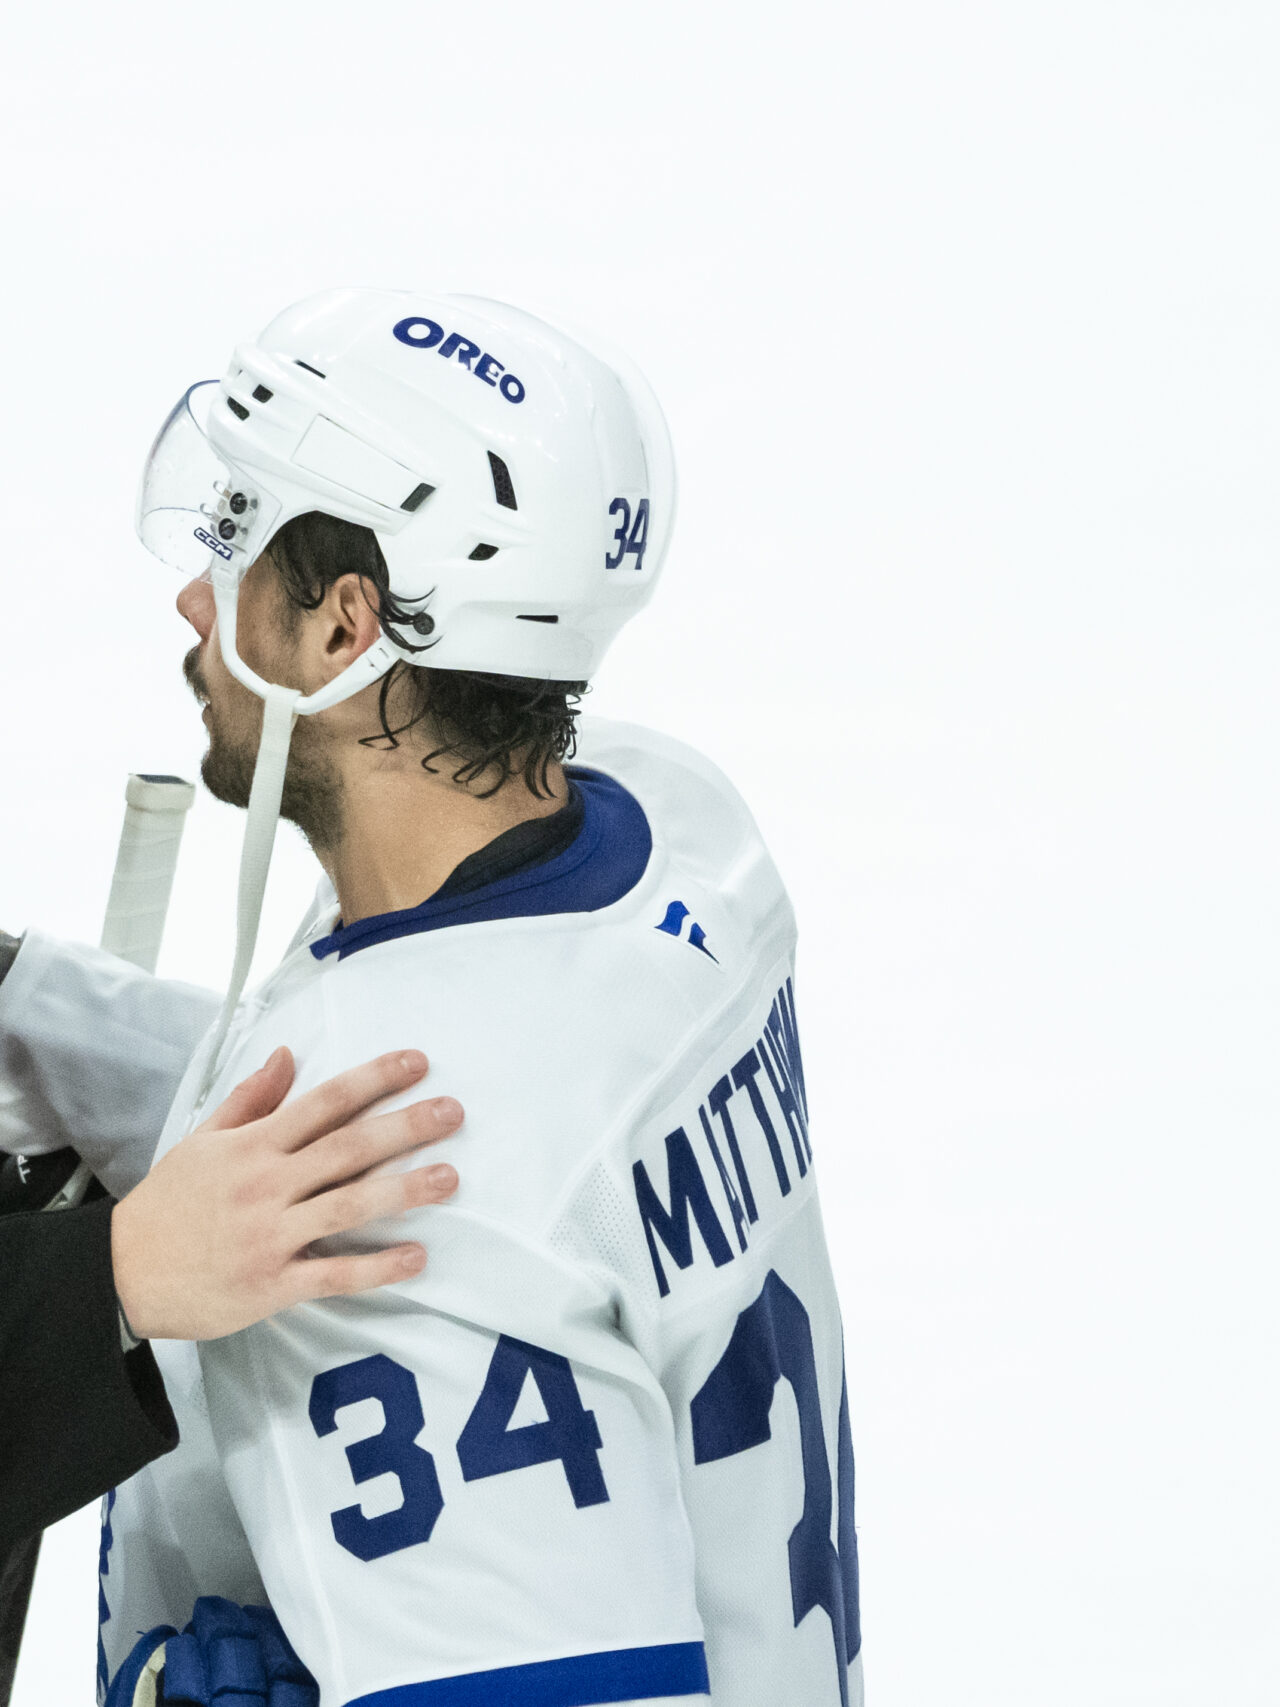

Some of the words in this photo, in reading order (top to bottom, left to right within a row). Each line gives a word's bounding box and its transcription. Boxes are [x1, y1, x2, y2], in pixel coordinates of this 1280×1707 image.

[393, 317, 526, 404] OREO
[194, 527, 233, 561] CCM
[606, 497, 650, 570] 34
[308, 1333, 611, 1563] 34
